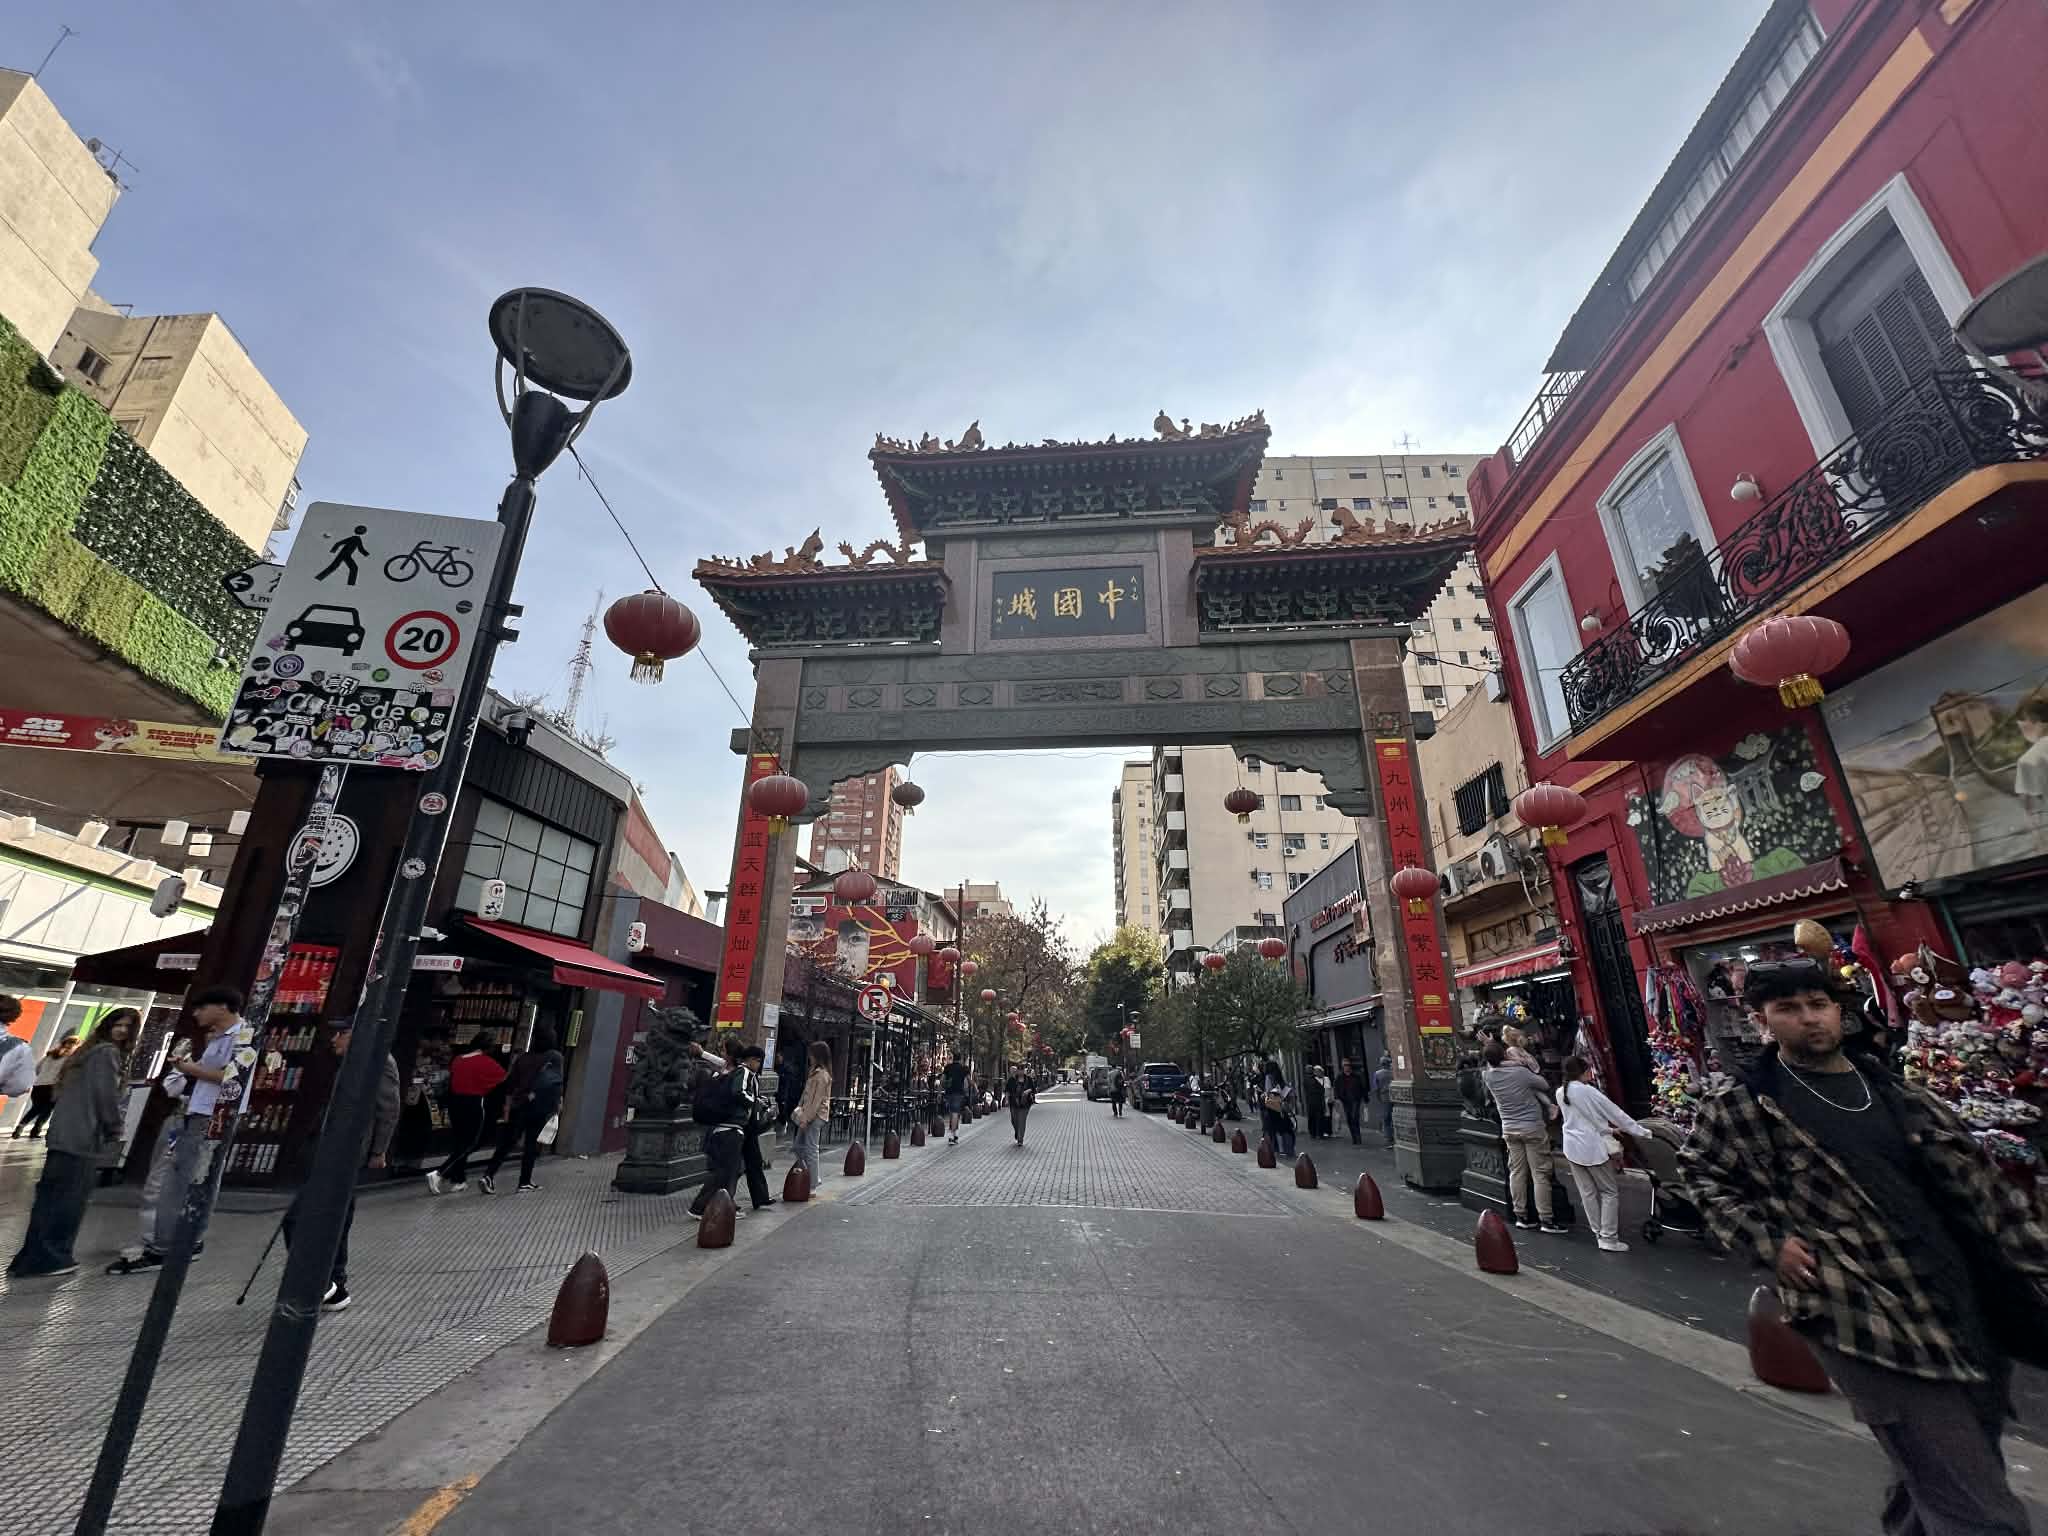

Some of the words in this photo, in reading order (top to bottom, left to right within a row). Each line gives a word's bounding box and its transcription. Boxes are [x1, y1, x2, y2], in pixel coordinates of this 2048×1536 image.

[1007, 579, 1126, 621] 中國城
[399, 626, 445, 653] 20
[287, 692, 361, 717] Clle
[371, 701, 406, 720] de
[21, 717, 65, 731] 25
[1386, 768, 1440, 982] 九州大地繁荣
[727, 812, 768, 980] 蓝天群星灿烂
